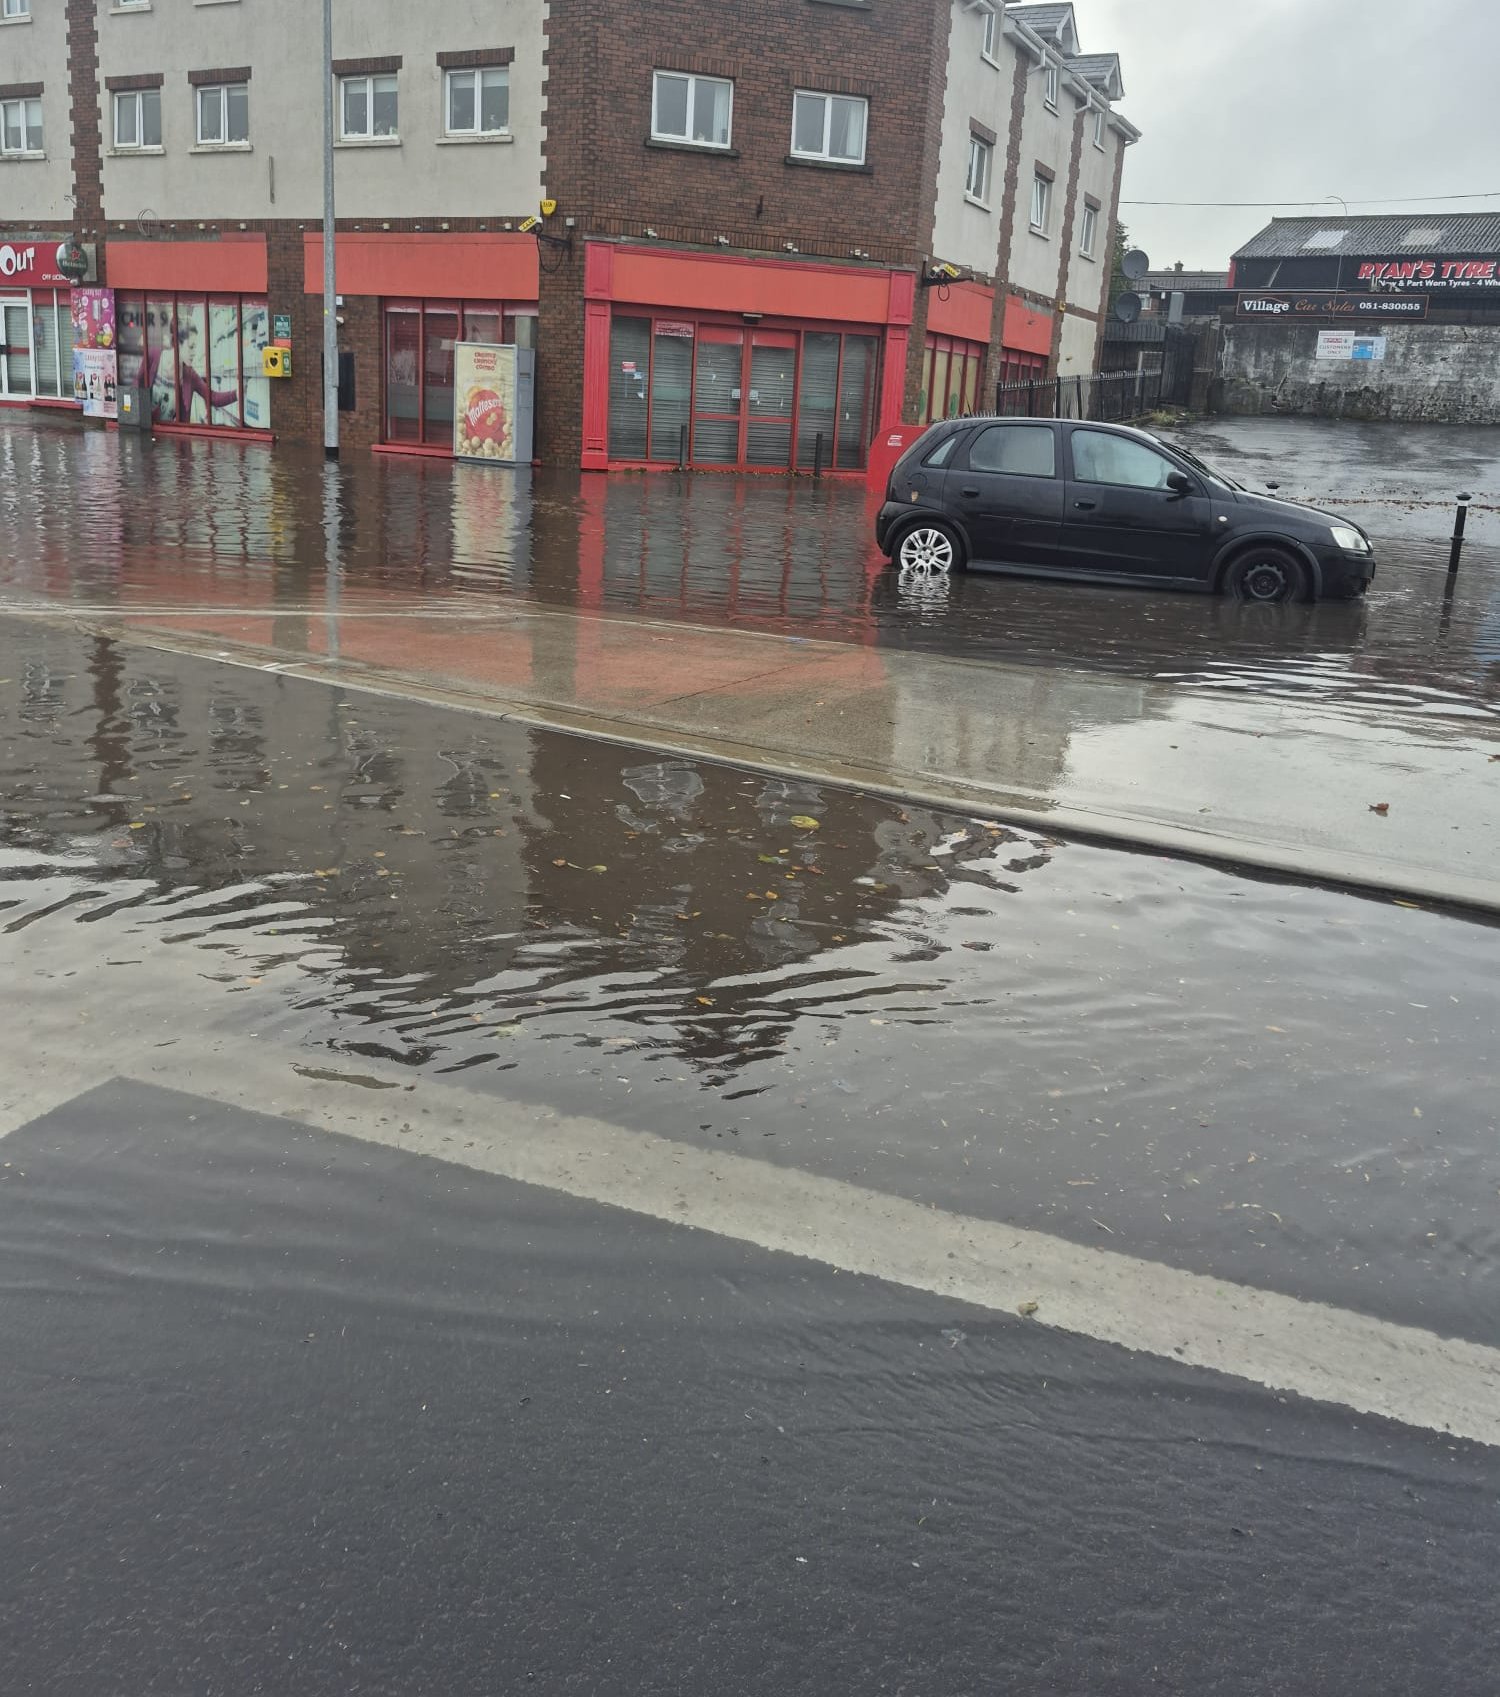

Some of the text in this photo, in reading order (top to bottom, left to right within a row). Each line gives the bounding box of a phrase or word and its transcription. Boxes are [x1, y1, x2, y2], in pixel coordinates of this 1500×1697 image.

[1357, 261, 1436, 279] RYAN'S
[1441, 262, 1496, 278] TYRE
[1406, 279, 1423, 287] Part
[1425, 279, 1446, 287] Worn
[1449, 280, 1470, 289] Tyres
[1477, 279, 1482, 287] 4
[1243, 299, 1421, 313] Village Car Sales 051-830555
